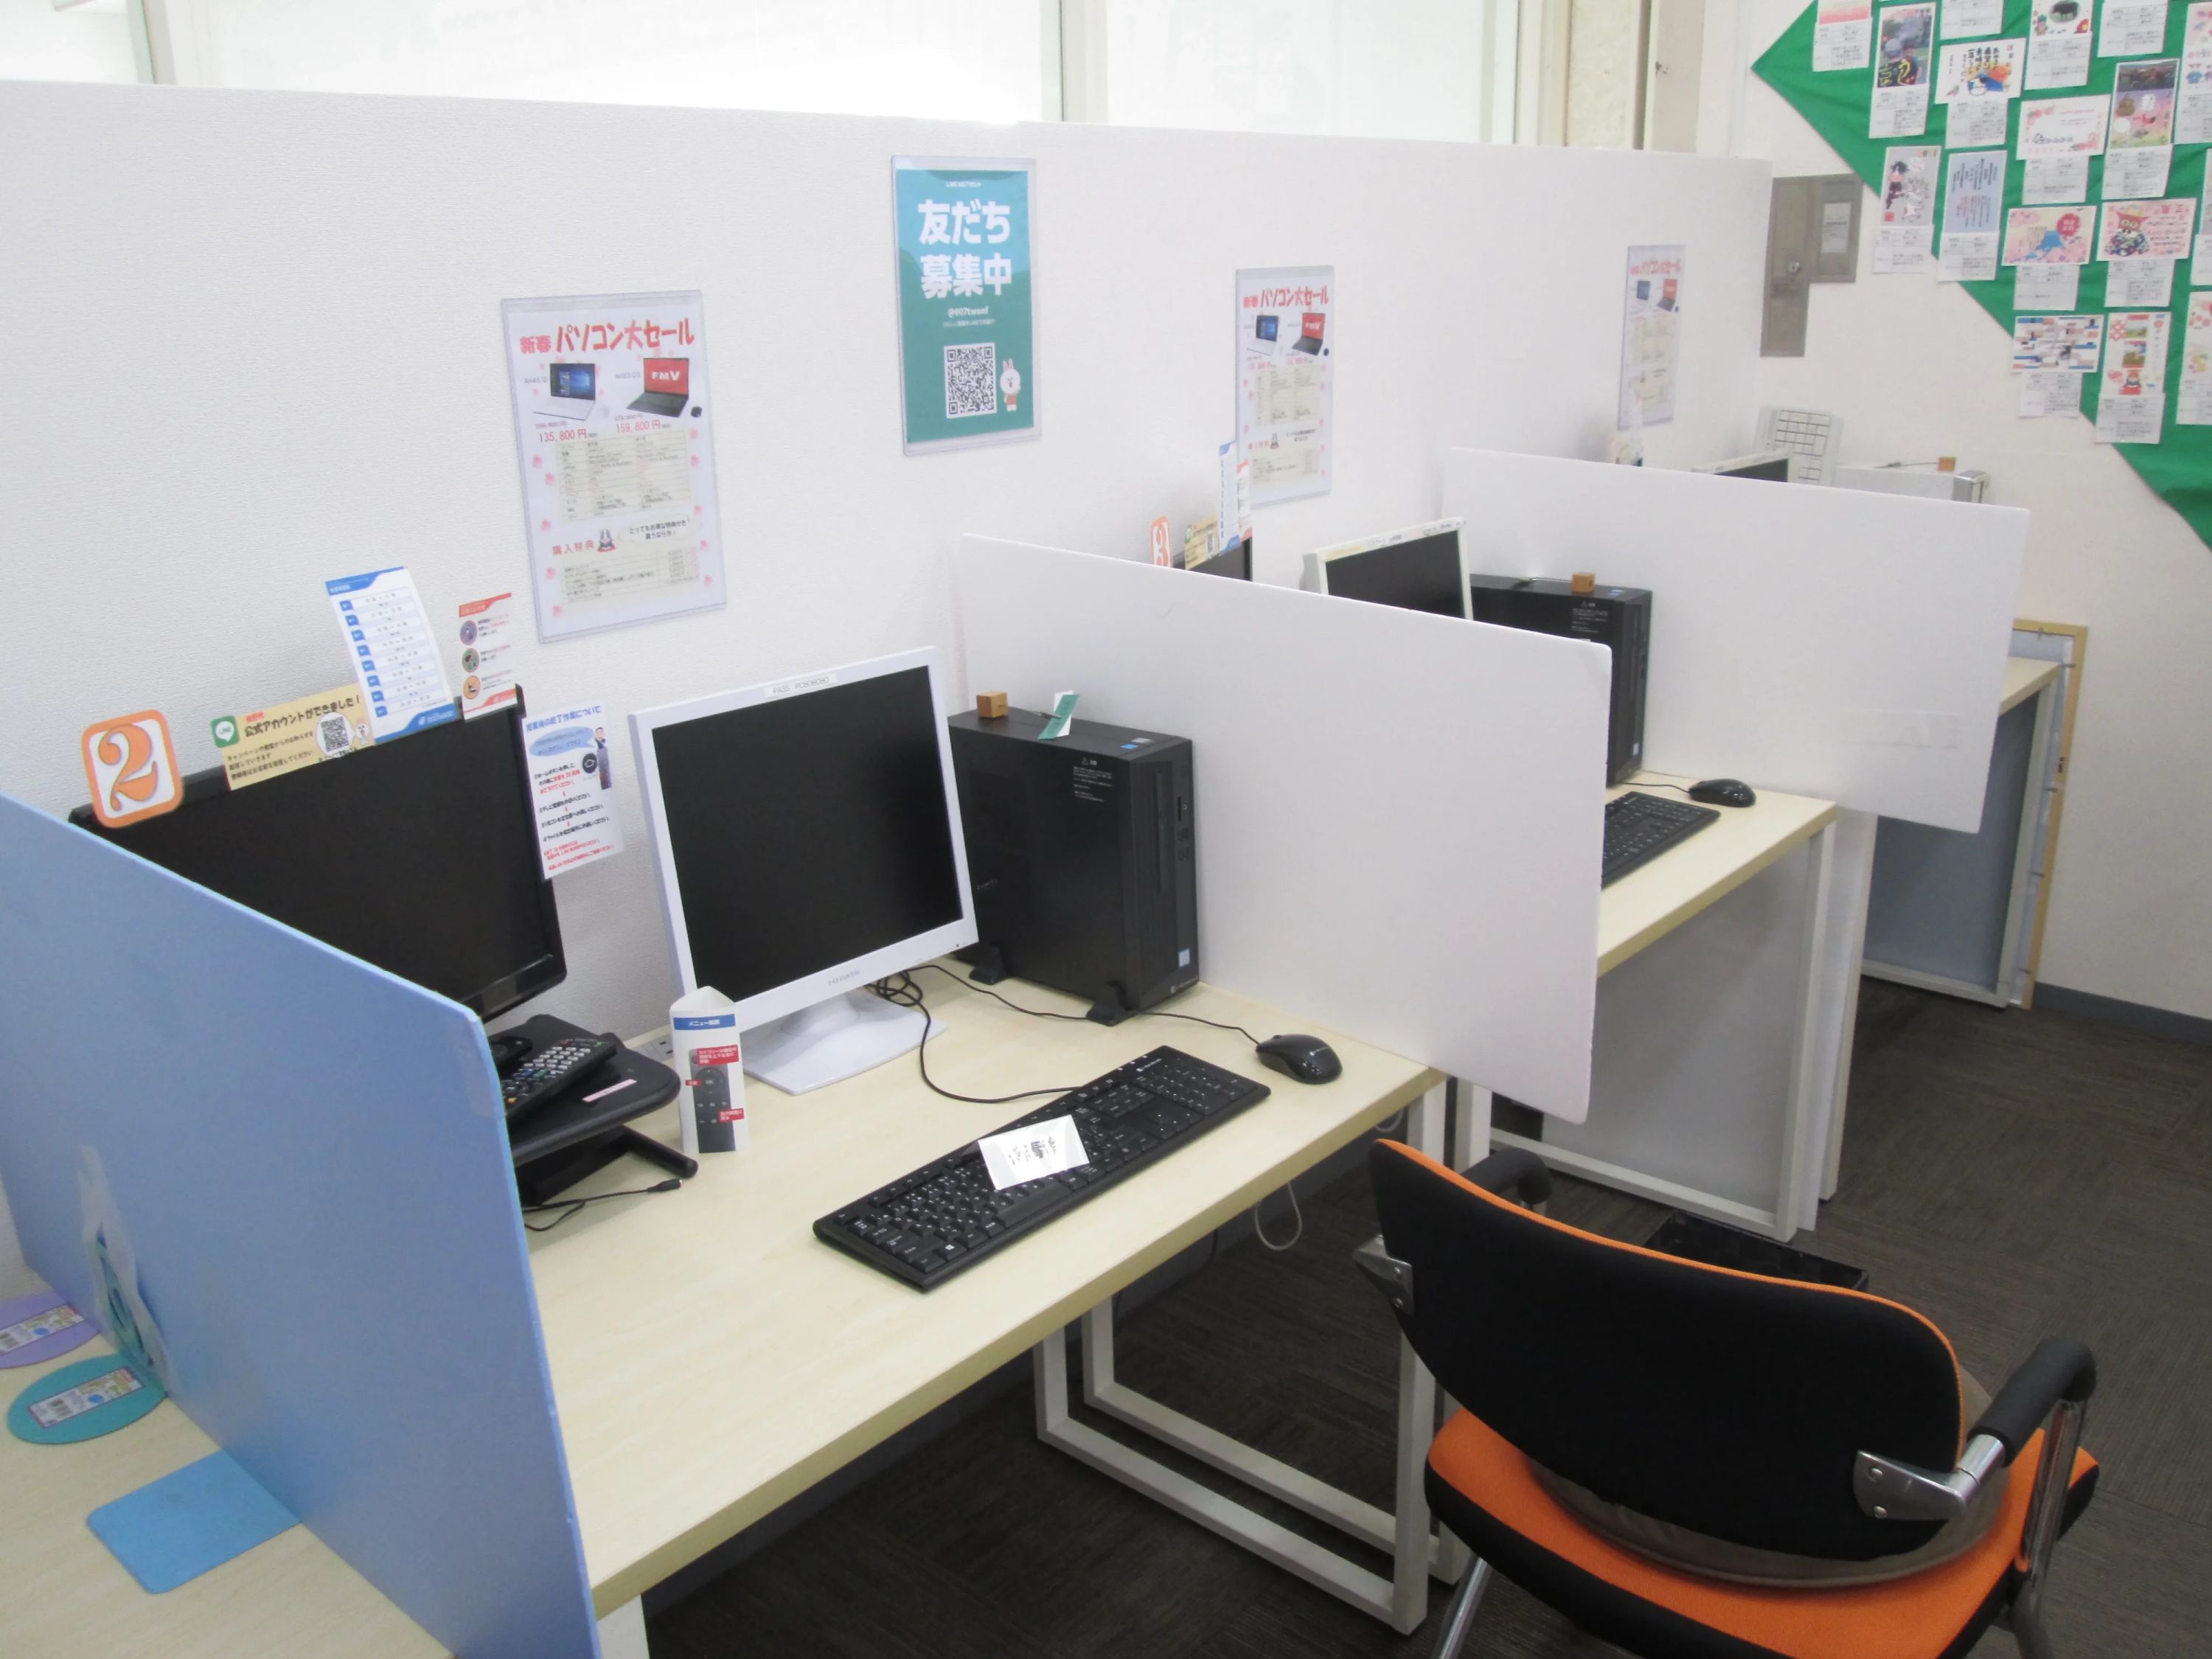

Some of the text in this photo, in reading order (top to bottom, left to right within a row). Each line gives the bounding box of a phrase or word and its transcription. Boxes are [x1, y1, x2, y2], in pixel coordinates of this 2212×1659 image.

[918, 198, 1010, 245] 友だち
[920, 252, 1012, 299] 募集中
[520, 318, 695, 354] 新春 パソコン大セール
[651, 371, 681, 381] FMV
[99, 723, 159, 813] 2
